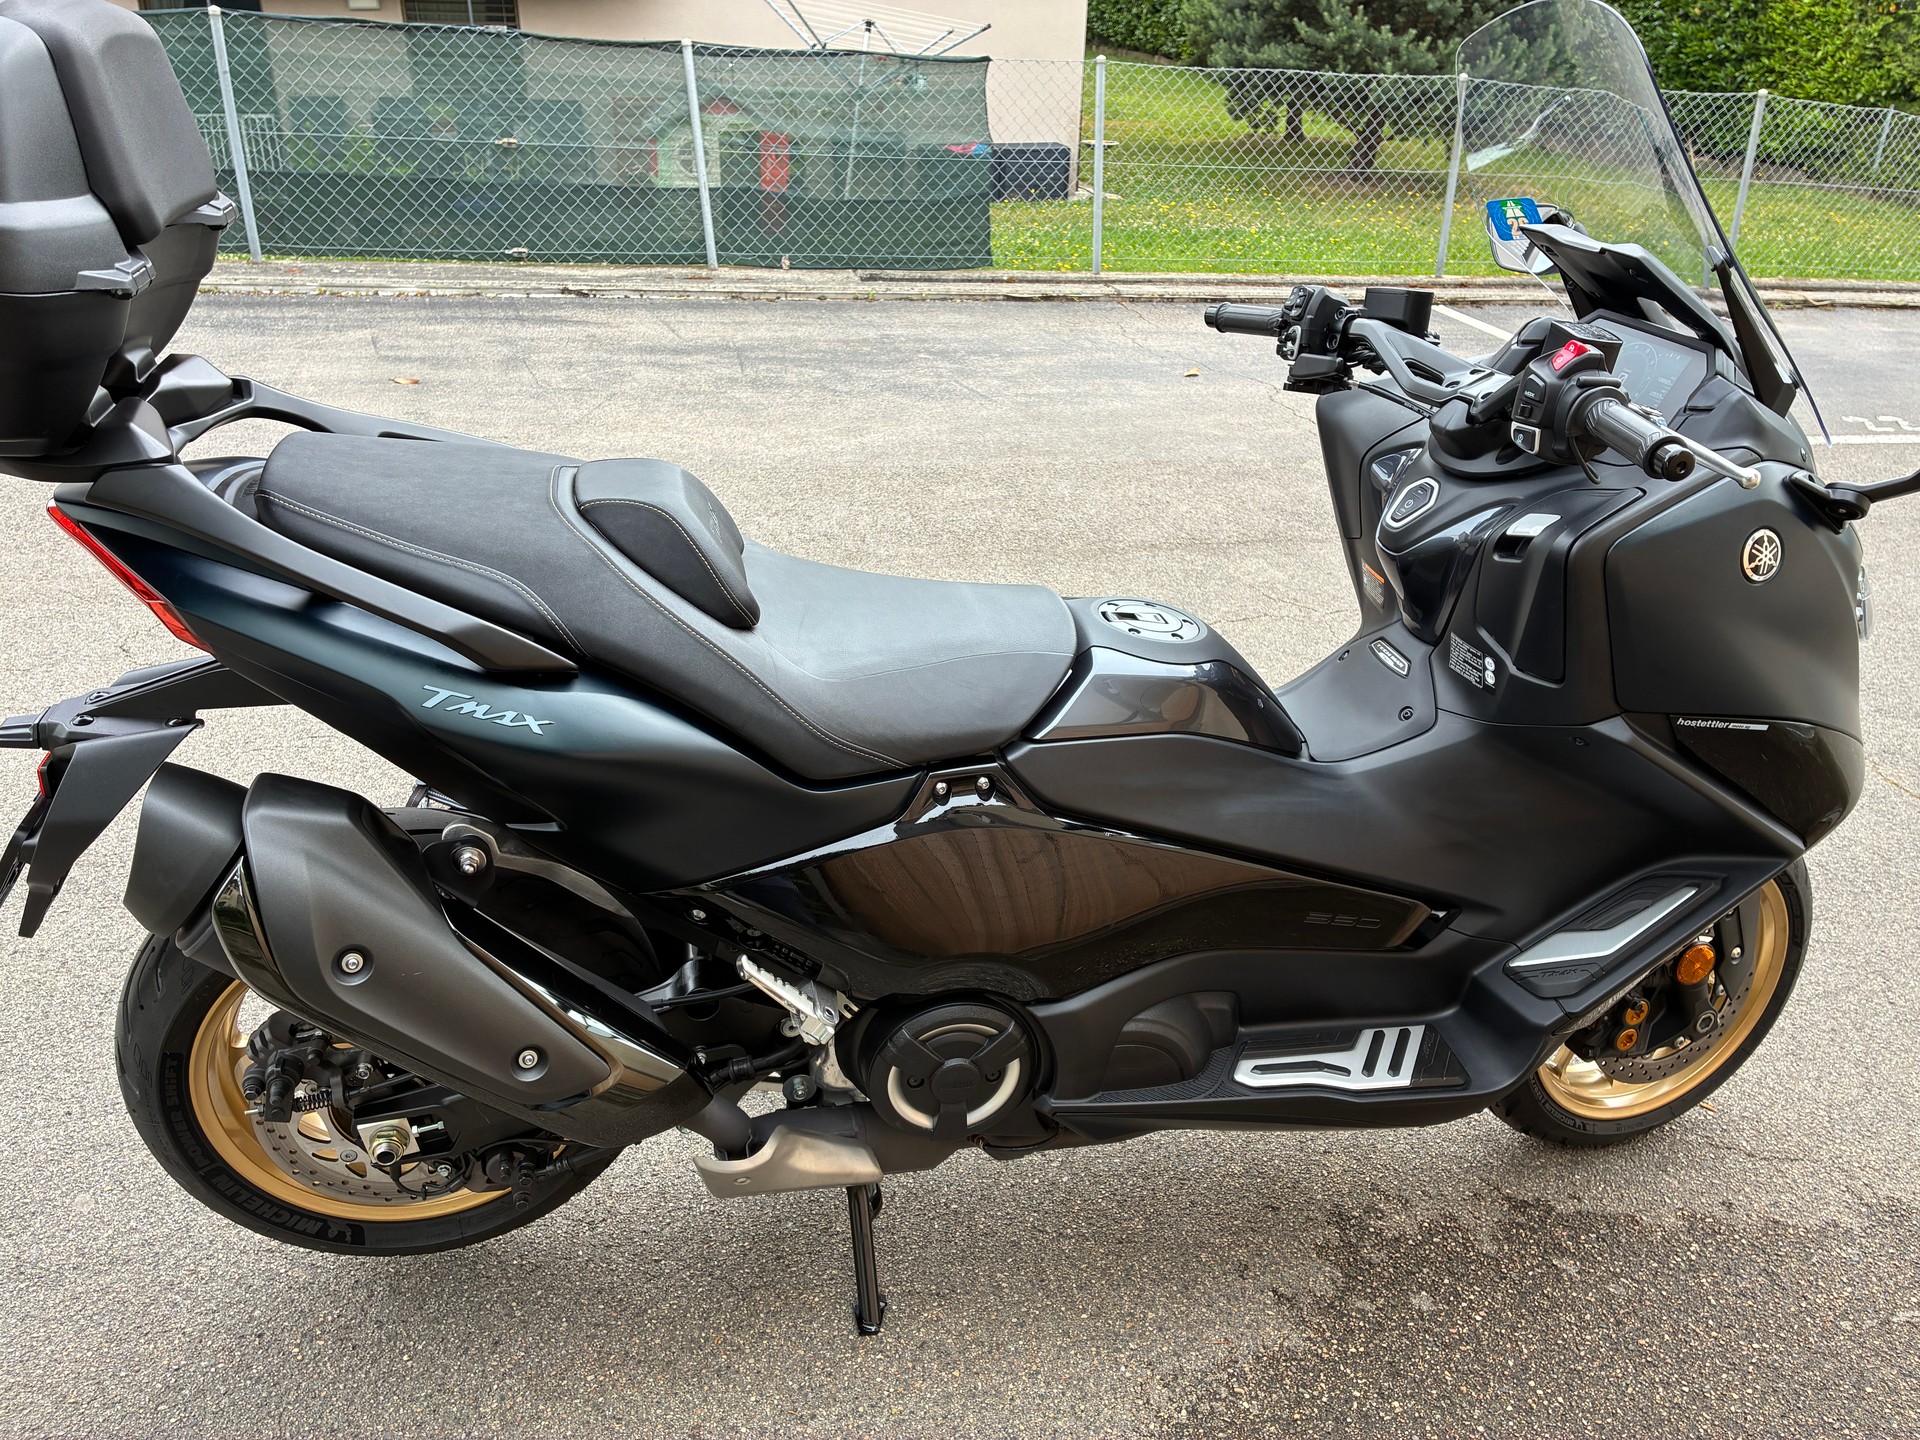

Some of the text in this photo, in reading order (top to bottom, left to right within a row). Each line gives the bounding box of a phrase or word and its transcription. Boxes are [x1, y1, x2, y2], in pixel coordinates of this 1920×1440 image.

[421, 684, 556, 736] TMAX
[1677, 717, 1729, 728] hostettler
[1304, 912, 1382, 929] 560
[171, 1111, 208, 1170] POWER
[211, 1174, 324, 1234] MICHELIN
